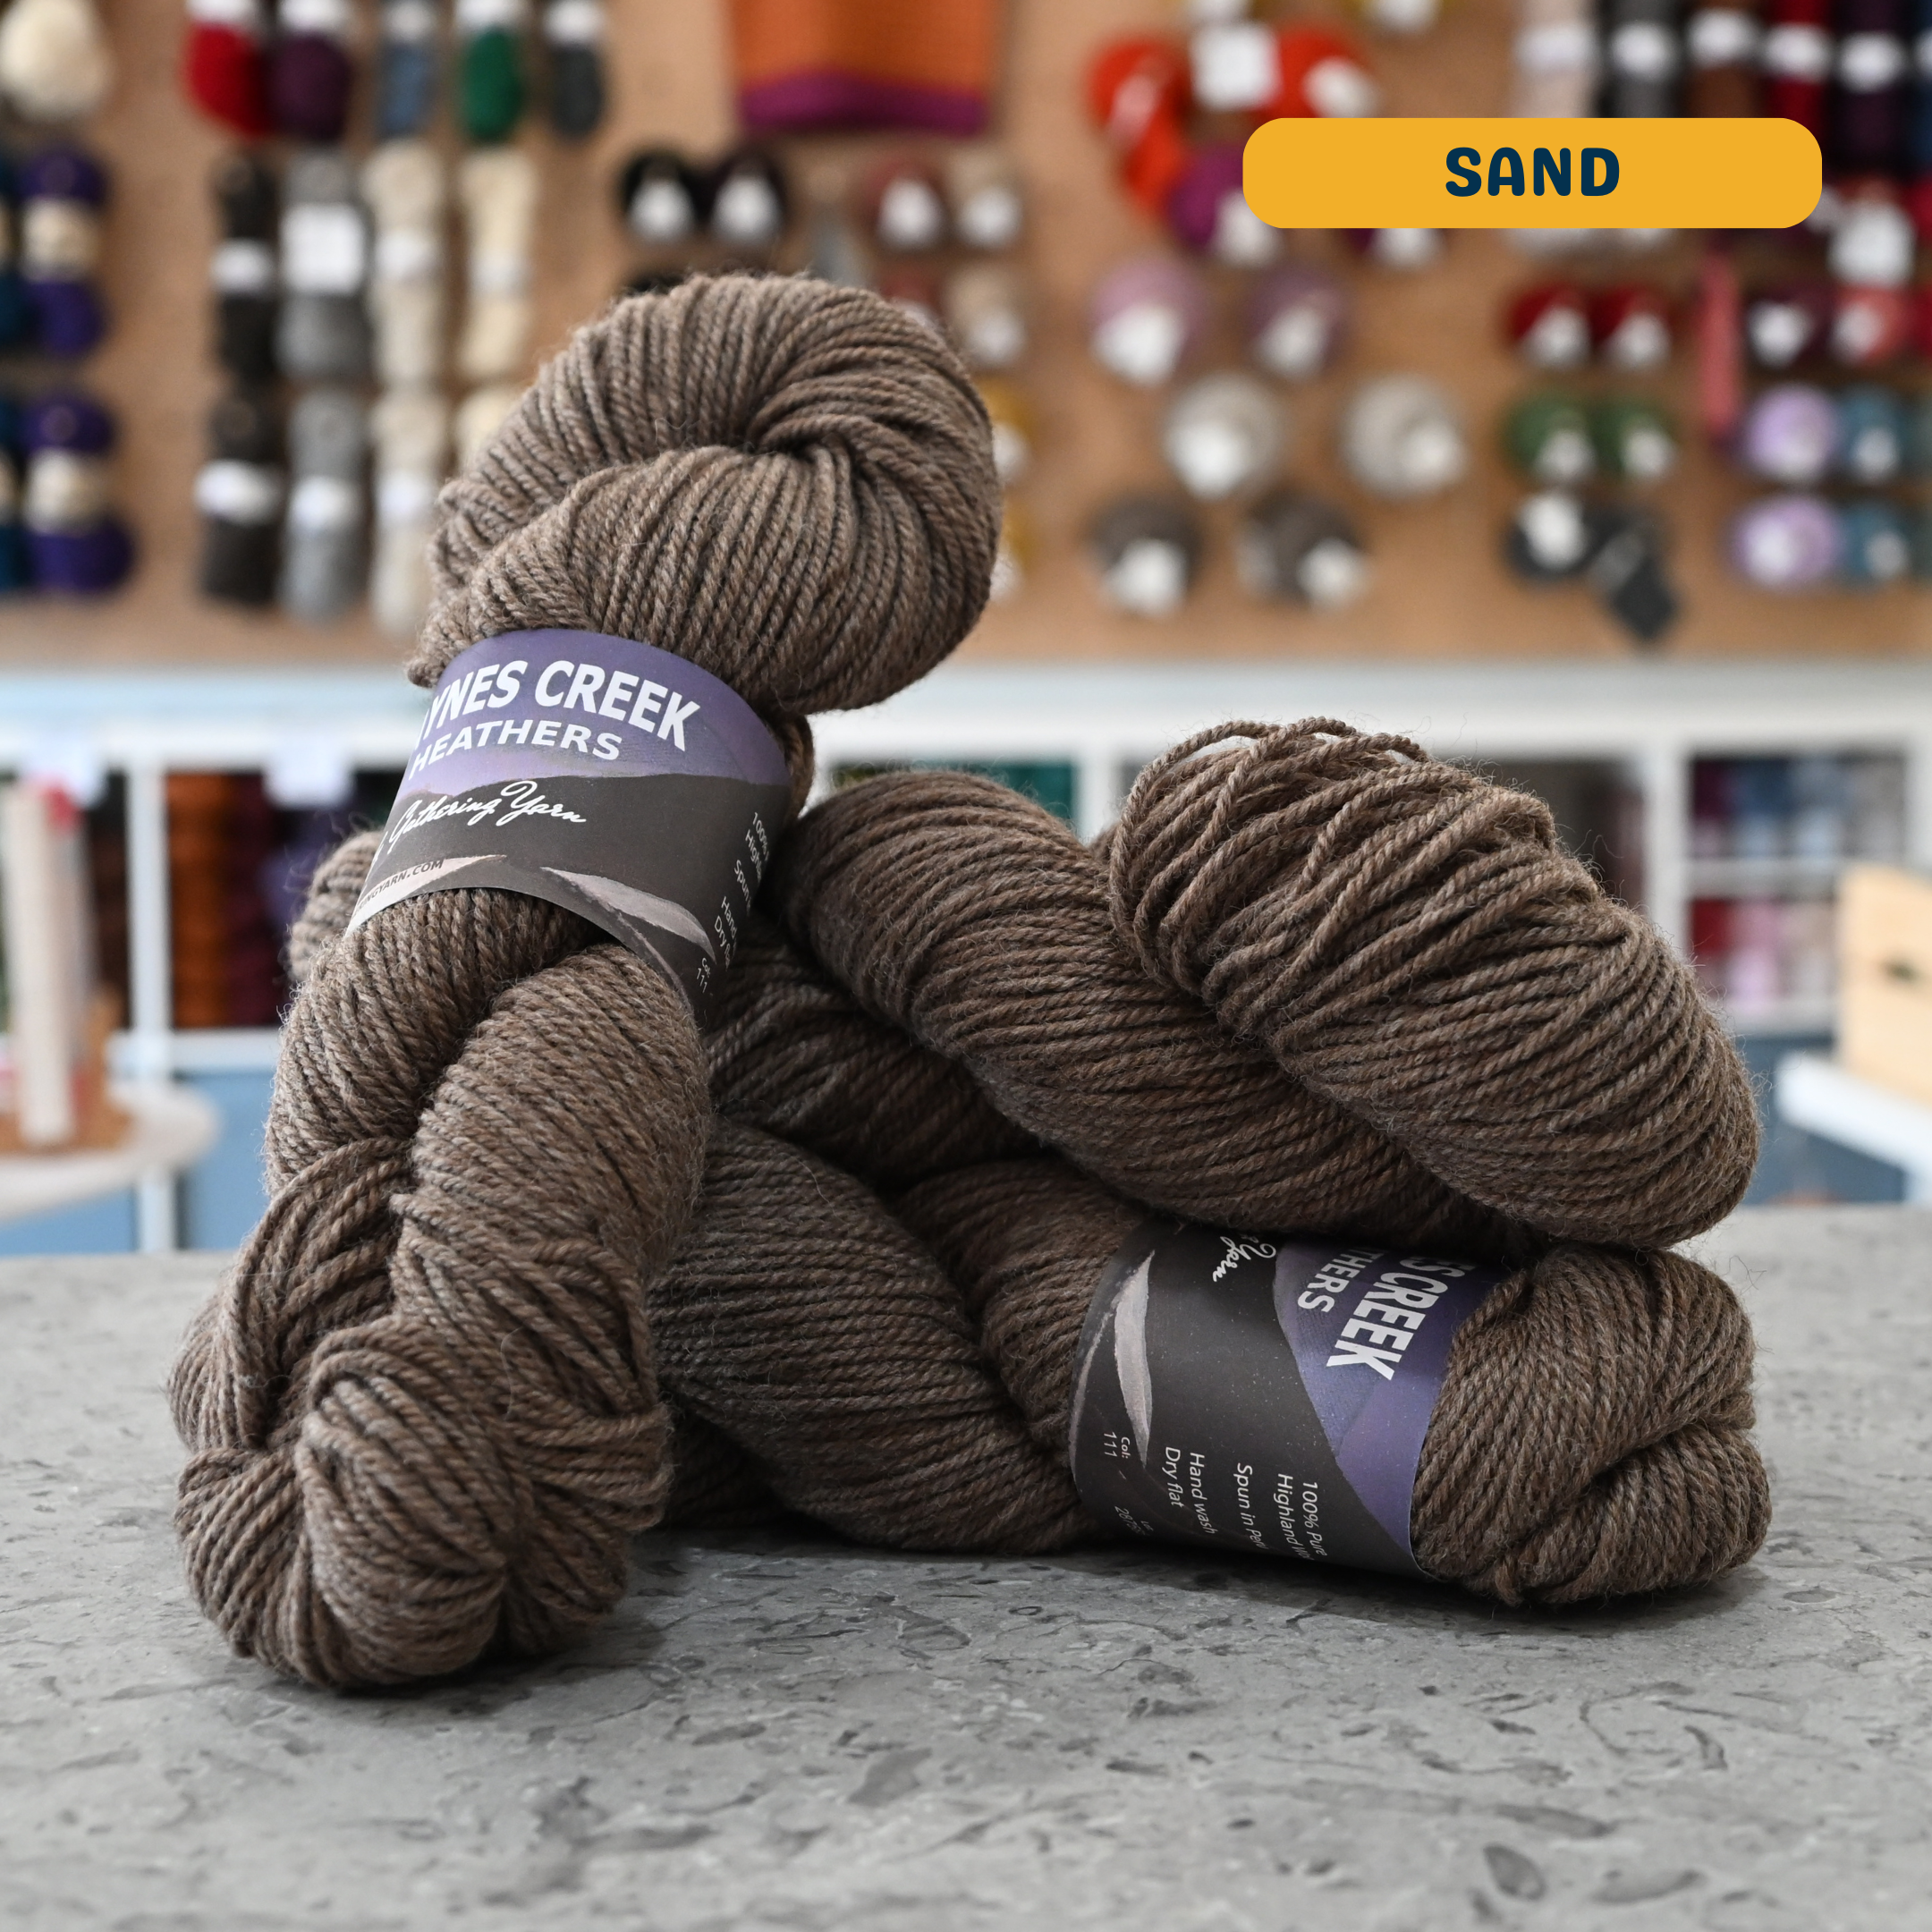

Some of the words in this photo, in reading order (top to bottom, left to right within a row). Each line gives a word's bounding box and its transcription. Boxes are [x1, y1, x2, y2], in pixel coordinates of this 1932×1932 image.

[535, 660, 700, 751] CREEK
[409, 719, 623, 781] HEATHERS
[387, 794, 503, 855] Gathering
[496, 780, 587, 826] Yarn
[733, 859, 750, 902] Spun
[714, 915, 727, 948] Dry
[721, 895, 738, 939] Hand
[696, 967, 708, 993] 111
[1212, 1235, 1276, 1283] Yarn
[1297, 1249, 1387, 1313] THERS
[1326, 1272, 1448, 1380] CREEK
[1103, 1431, 1118, 1457] 111
[1121, 1436, 1131, 1459] Col:
[1161, 1446, 1181, 1480] Dry
[1166, 1482, 1185, 1508] flat
[1189, 1452, 1208, 1500] Hand
[1233, 1462, 1253, 1509] Spun
[1193, 1503, 1218, 1534] wash
[1241, 1512, 1256, 1526] in
[1273, 1473, 1304, 1546] Highland
[1302, 1481, 1319, 1528] 100%
[1306, 1530, 1327, 1556] Pure
